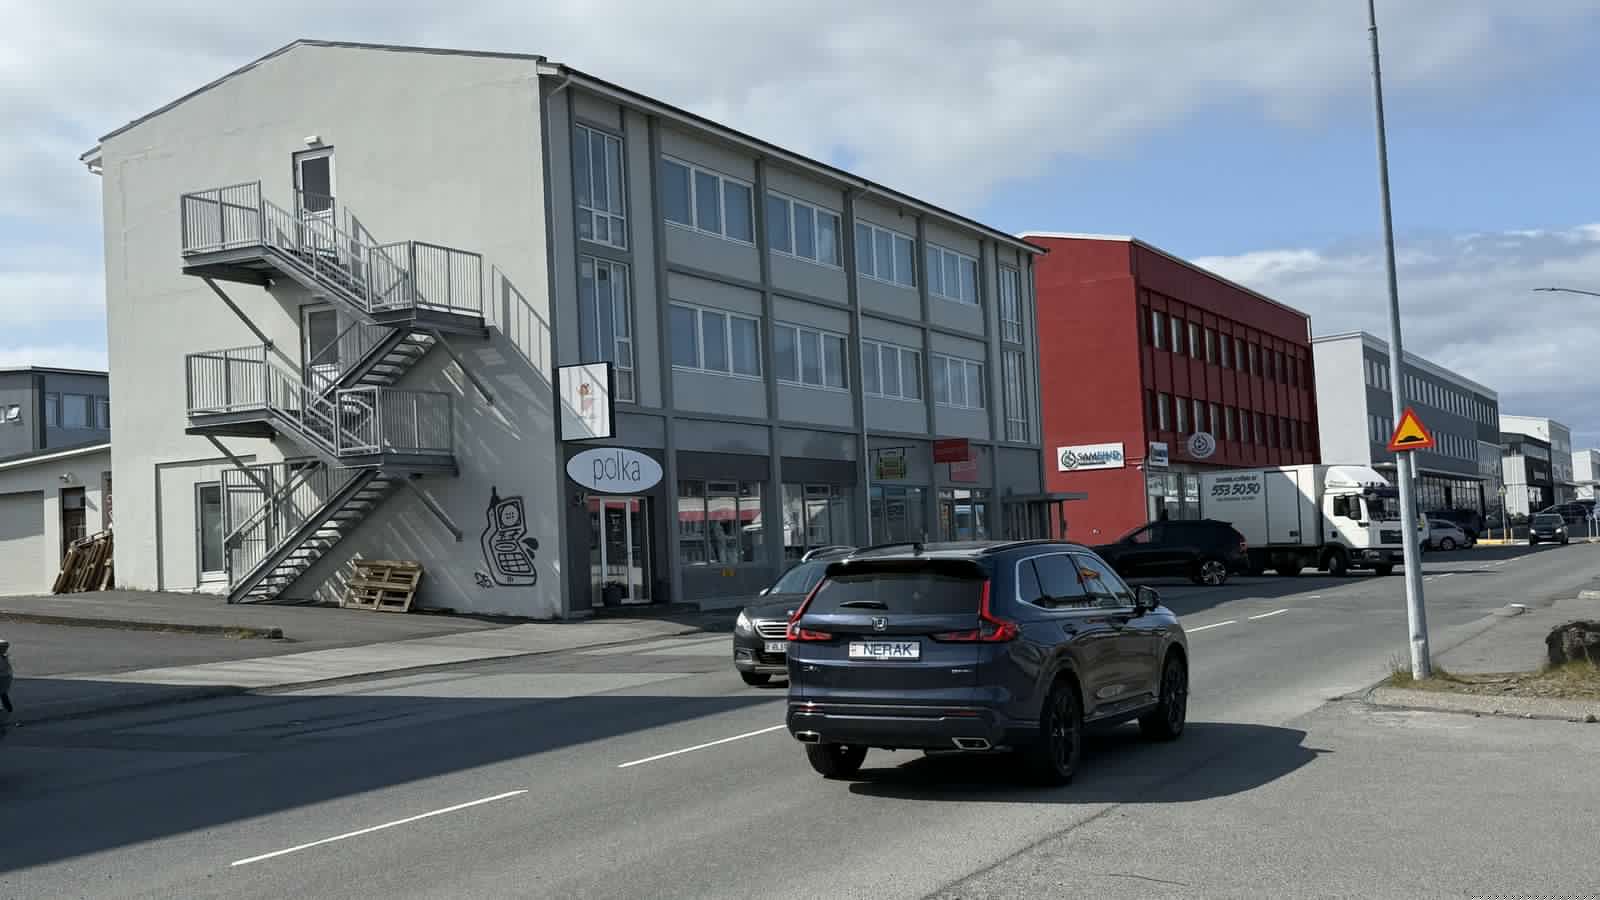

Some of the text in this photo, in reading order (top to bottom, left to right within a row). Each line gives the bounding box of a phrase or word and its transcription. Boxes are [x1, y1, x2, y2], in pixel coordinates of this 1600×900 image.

[592, 449, 641, 488] polka
[1211, 484, 1231, 496] 553
[863, 643, 913, 656] NERAK
